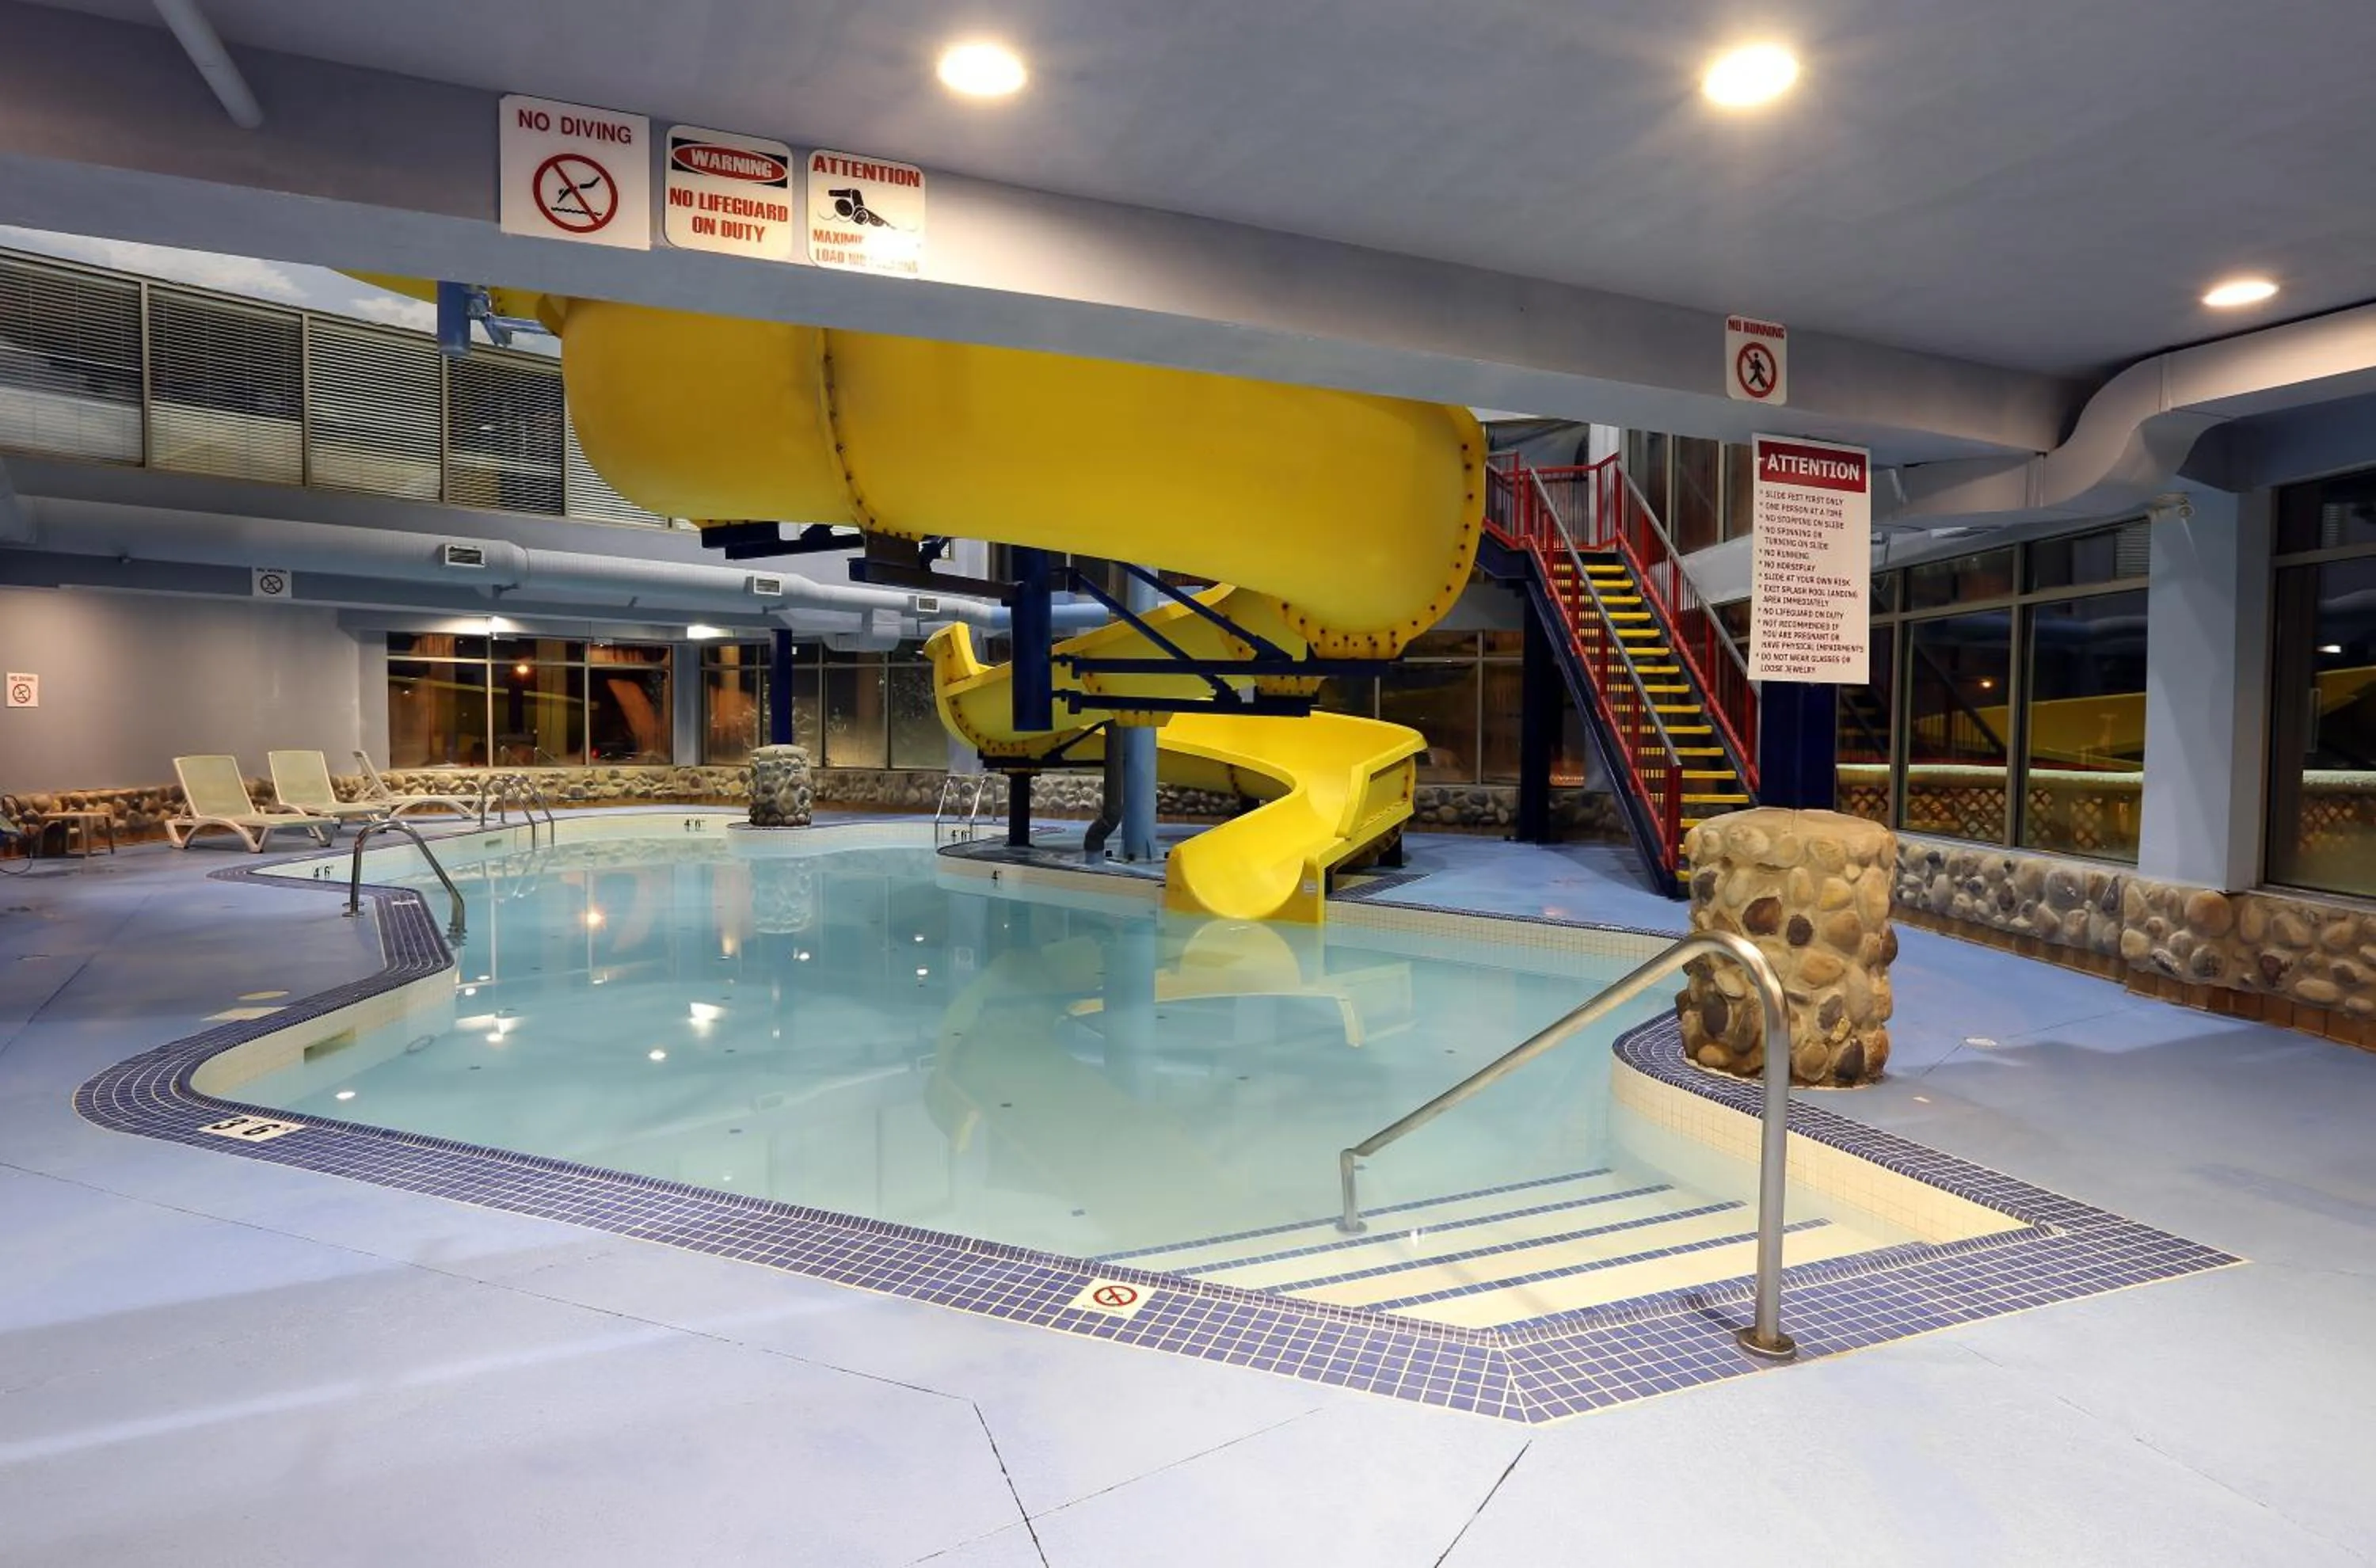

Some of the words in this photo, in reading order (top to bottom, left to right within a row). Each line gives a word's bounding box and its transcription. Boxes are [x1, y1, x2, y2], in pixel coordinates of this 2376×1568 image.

[519, 108, 550, 131] NO
[561, 116, 632, 144] DIVING
[691, 148, 773, 178] WARNING
[813, 154, 921, 188] ATTENTION
[669, 187, 694, 207] NO
[698, 192, 788, 223] LIFEGUARD
[692, 215, 717, 235] ON
[721, 219, 766, 243] DUTY
[1728, 319, 1742, 332] NO
[1743, 322, 1785, 340] RUNNING
[1767, 453, 1860, 481] ATTENTION
[1765, 490, 1786, 499] SLIDE
[1826, 497, 1844, 506] ONLY
[1782, 504, 1809, 514] PERSON
[1776, 516, 1811, 526] STOPPING
[1825, 520, 1845, 529] SLIDE
[1765, 526, 1776, 535] NO
[1777, 527, 1811, 538] SPINNING
[1765, 537, 1796, 546] TURNING
[1776, 561, 1816, 572] HORSEPLAY
[1764, 573, 1784, 581] SLIDE
[1783, 596, 1829, 607] IMMEDIATELY
[1775, 608, 1812, 618] LIFEGUARD
[1826, 611, 1844, 620] DUTY
[1779, 620, 1830, 630] RECOMMENDED
[1816, 645, 1864, 653] IMPAIRMENTS
[1761, 653, 1771, 661] DO
[1785, 665, 1816, 674] JEWELRY
